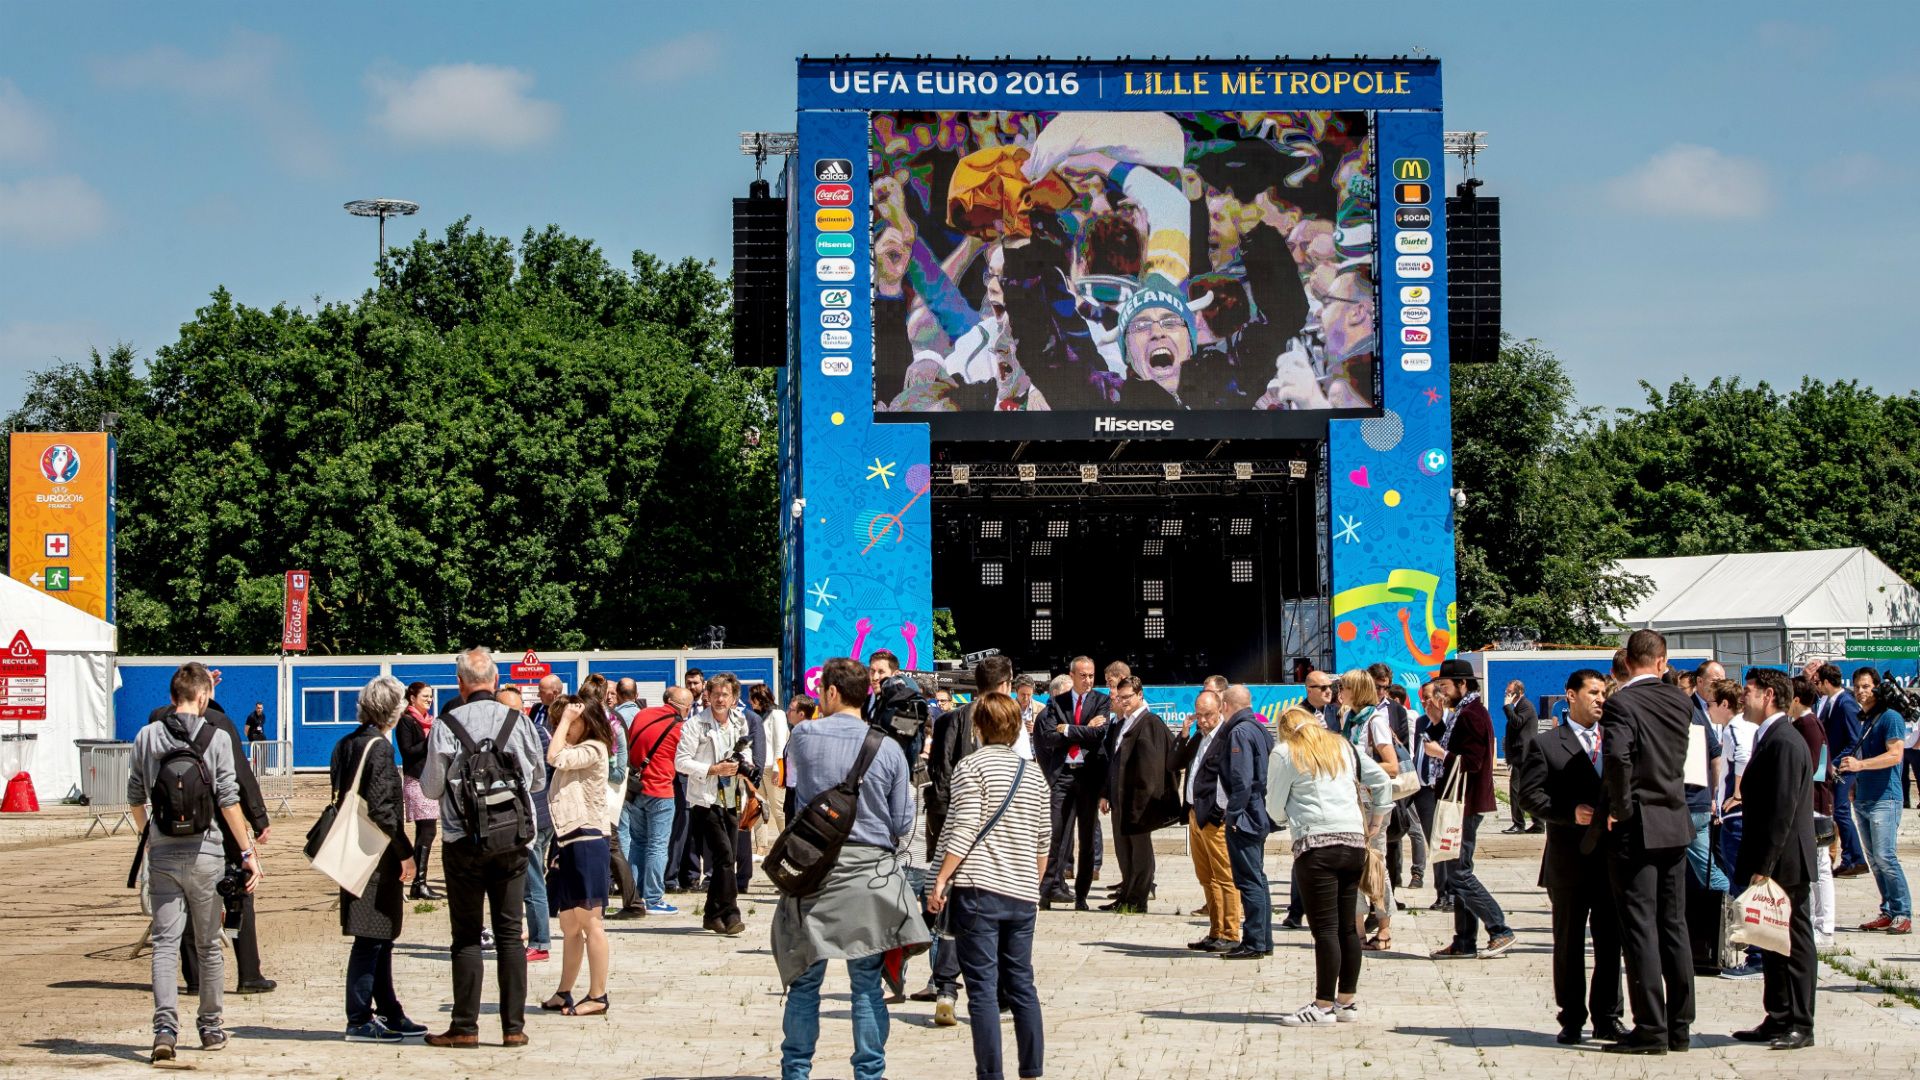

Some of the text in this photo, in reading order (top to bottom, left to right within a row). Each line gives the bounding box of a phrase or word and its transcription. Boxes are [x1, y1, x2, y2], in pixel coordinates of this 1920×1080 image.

[829, 70, 1080, 95] UEFA EURO 2016
[1124, 66, 1411, 95] LILLE MÉTROPOLE
[819, 172, 849, 180] adidas
[1403, 214, 1430, 222] SOCAR
[1400, 236, 1428, 246] Tourtel
[1406, 333, 1426, 341] SNCF
[1095, 416, 1174, 432] Hisense
[1906, 645, 1919, 653] EXIT
